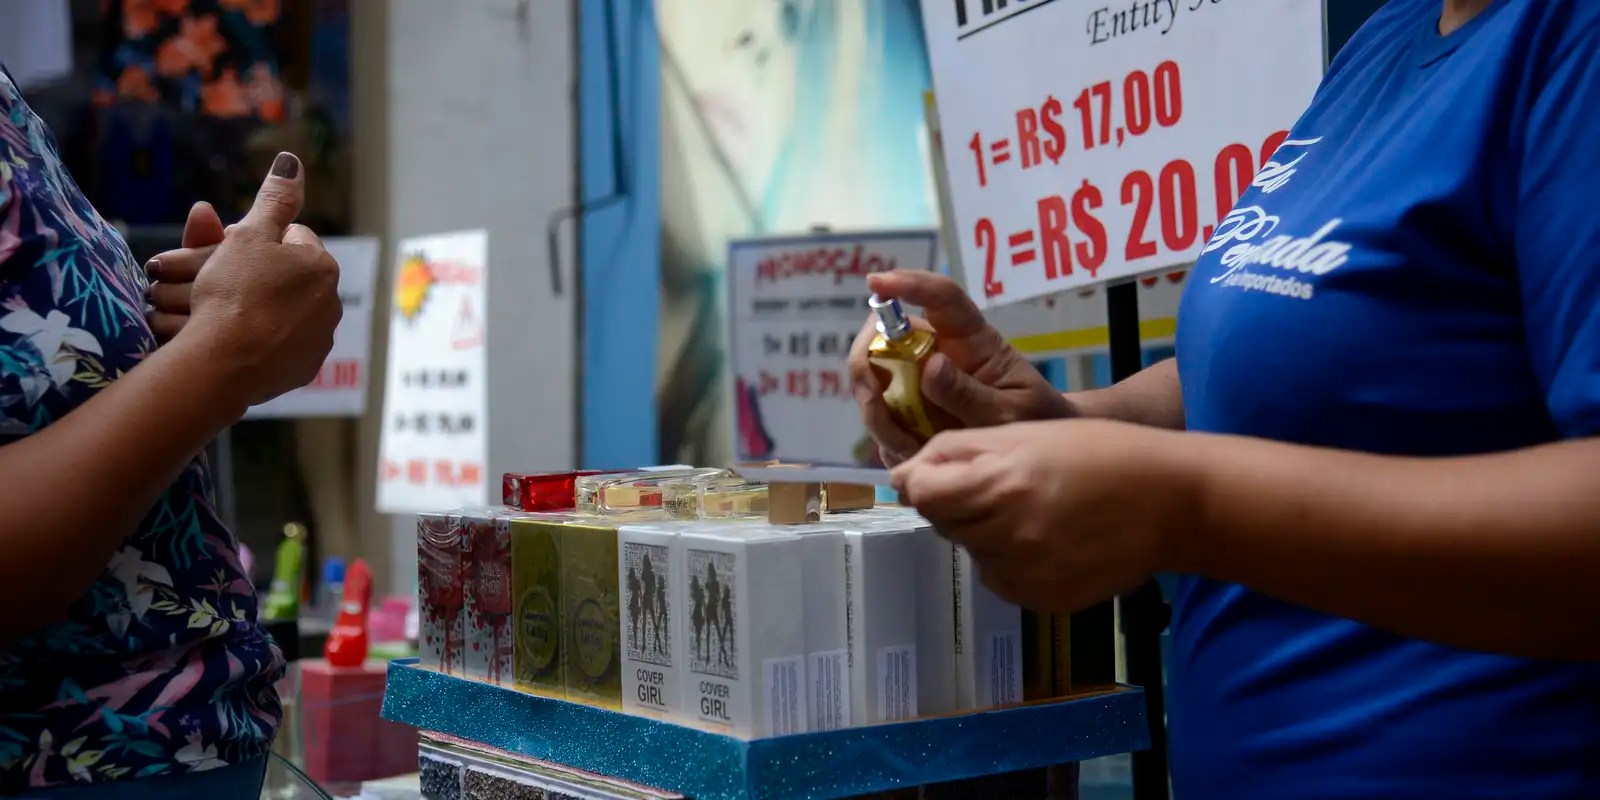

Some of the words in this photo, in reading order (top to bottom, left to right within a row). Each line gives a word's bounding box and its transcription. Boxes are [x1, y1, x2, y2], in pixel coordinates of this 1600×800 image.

[1086, 0, 1178, 46] Entity
[1015, 95, 1067, 170] R$
[1073, 60, 1182, 150] 17,00
[636, 668, 665, 686] COVER
[637, 684, 666, 706] GIRL
[700, 680, 730, 699] COVER
[700, 697, 731, 720] GIRL
